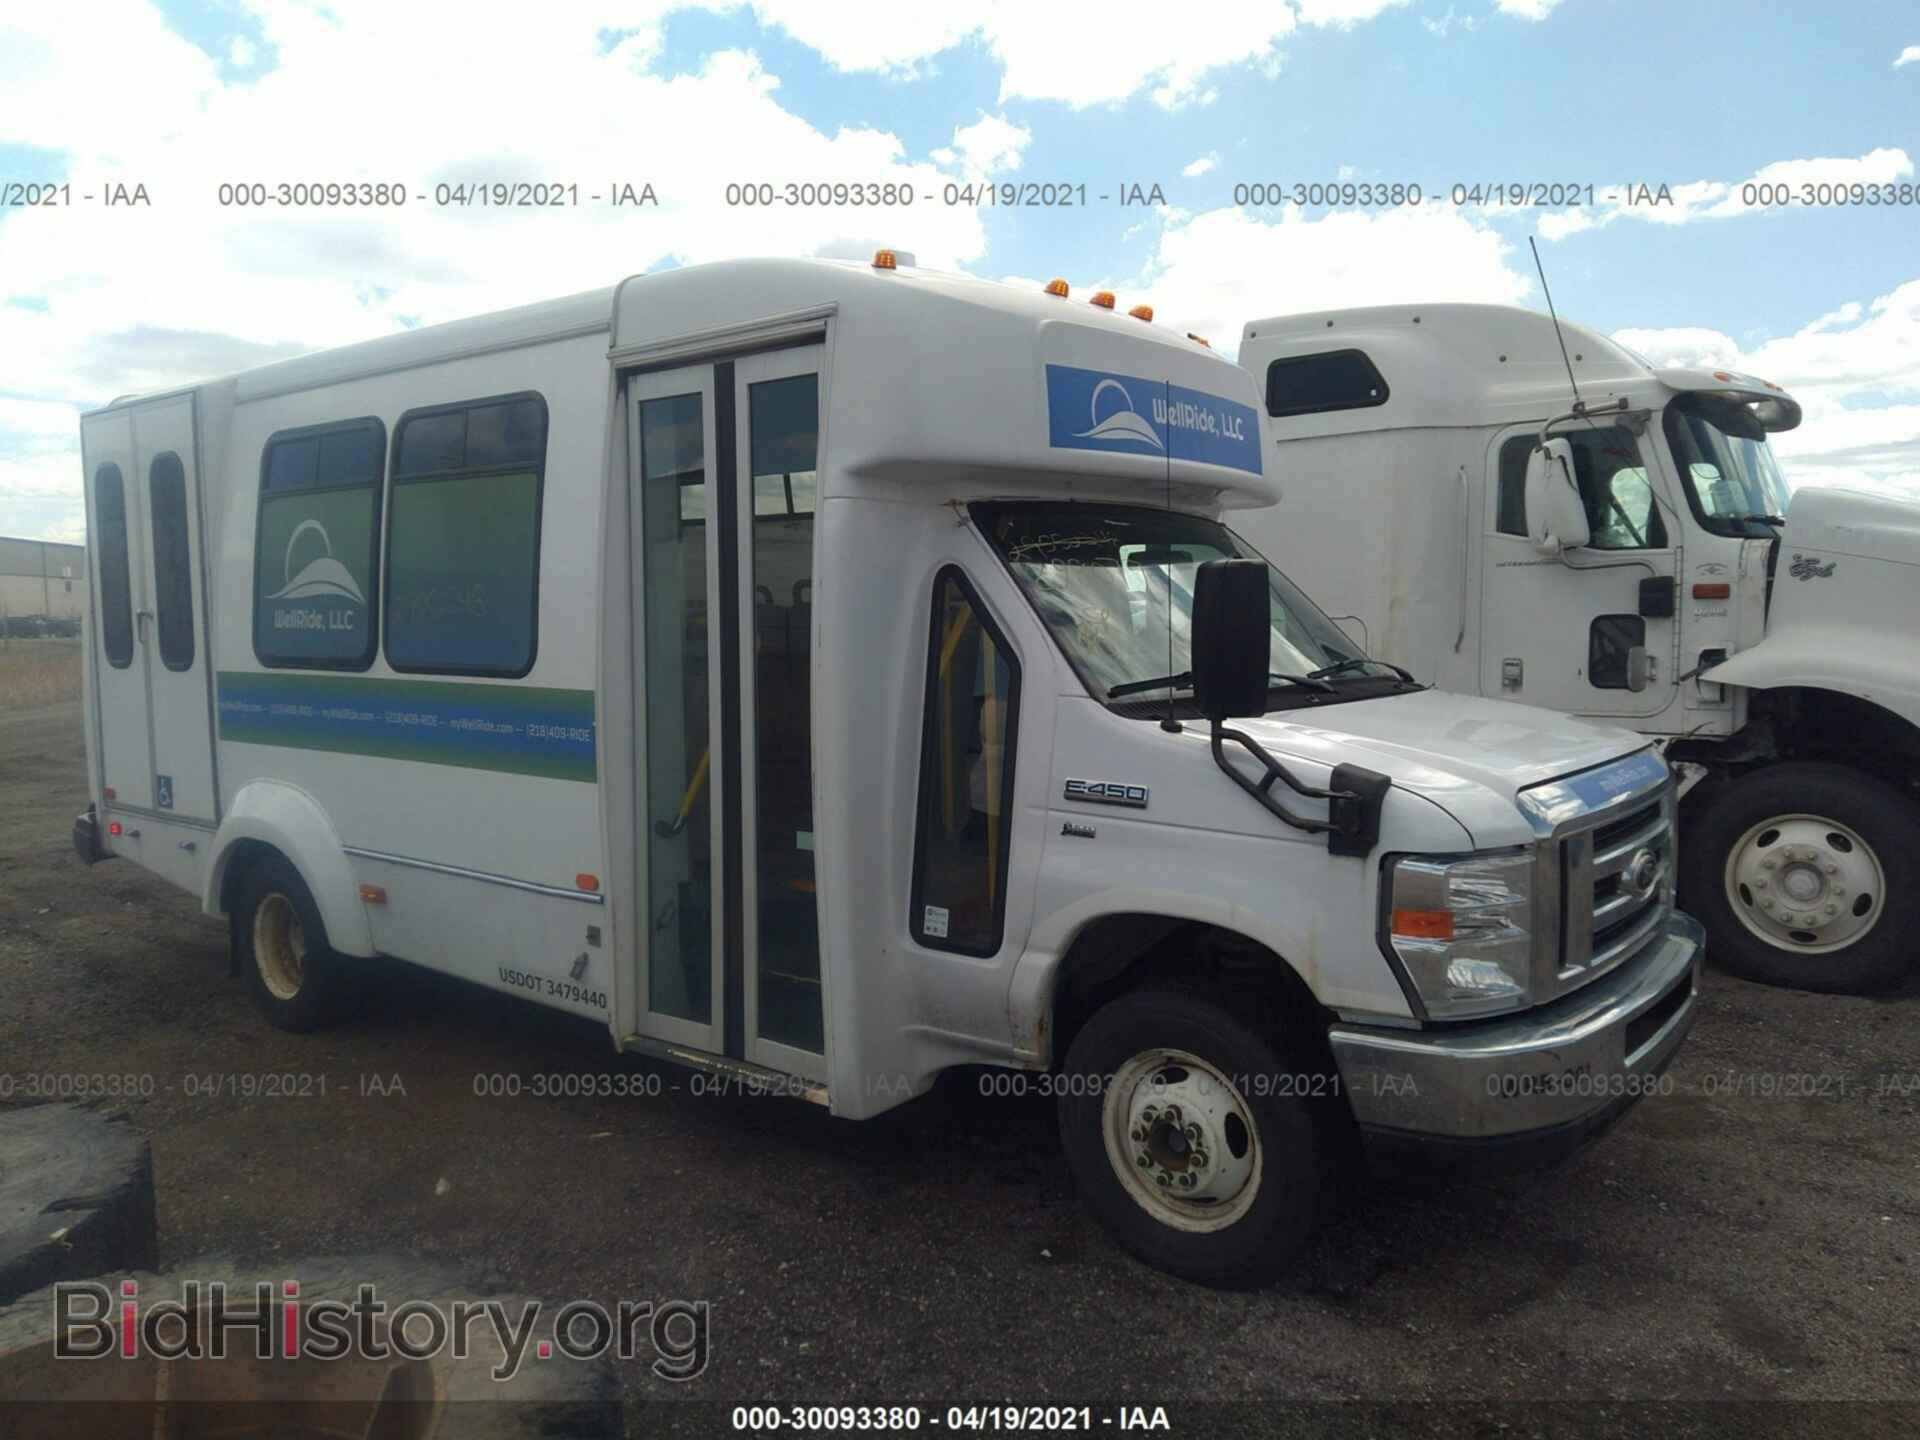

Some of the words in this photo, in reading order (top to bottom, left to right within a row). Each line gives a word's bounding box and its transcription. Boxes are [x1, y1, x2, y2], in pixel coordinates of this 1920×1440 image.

[1152, 398, 1219, 438] WellRide,
[1221, 413, 1244, 441] LLC
[329, 609, 354, 631] LLC
[498, 967, 543, 993] USDOT
[546, 979, 608, 1009] 3479440
